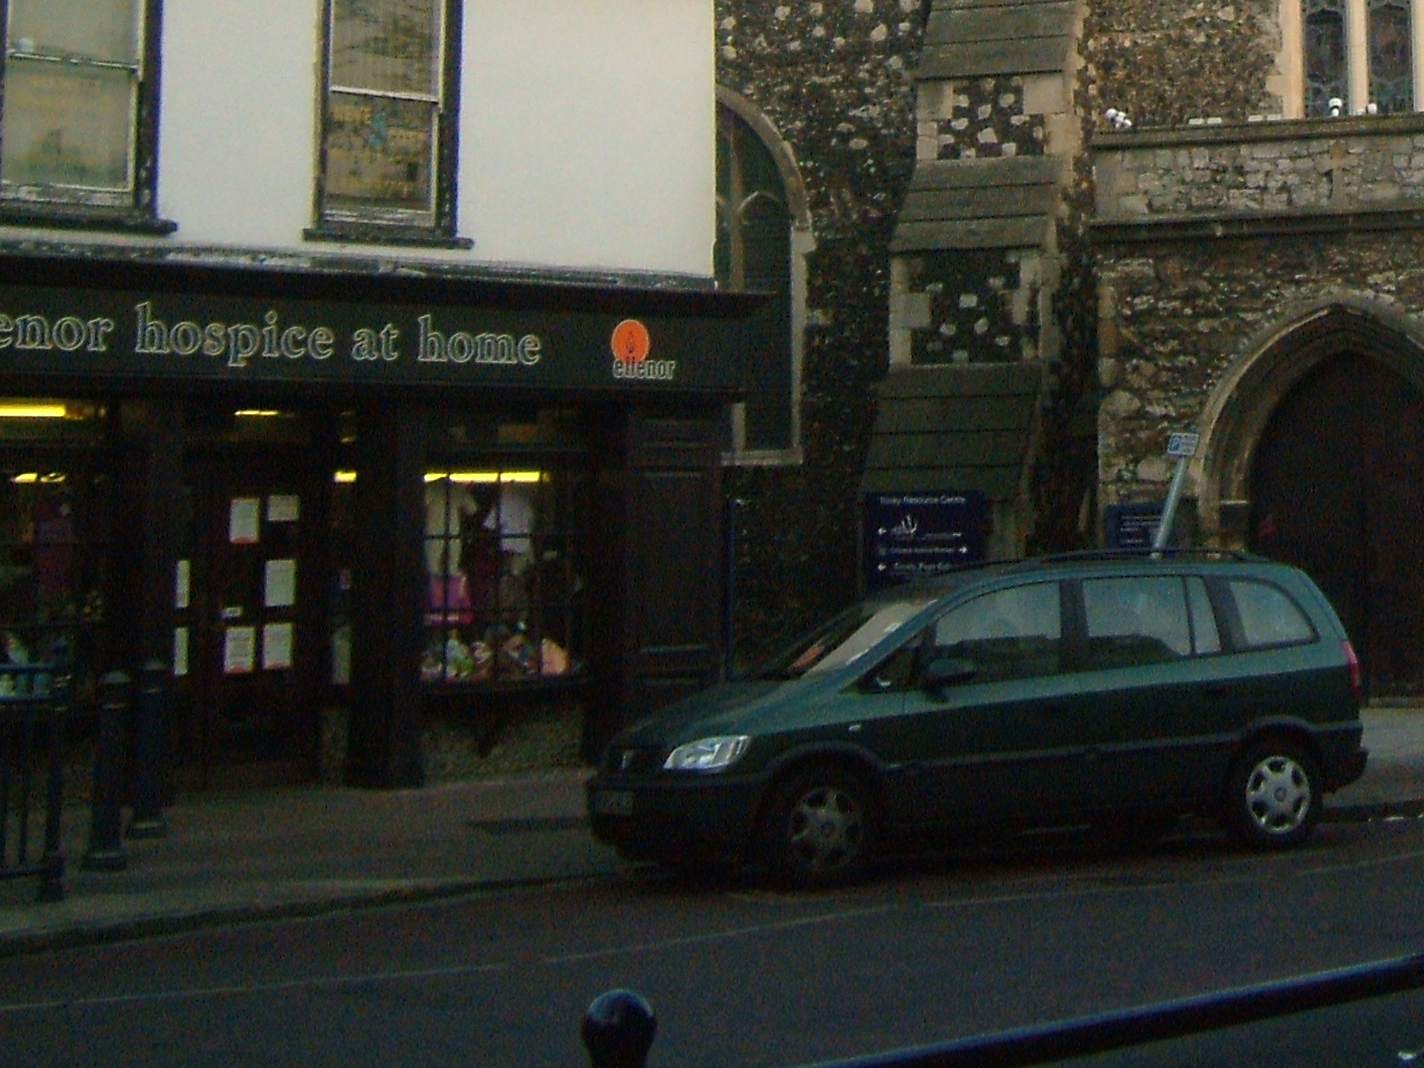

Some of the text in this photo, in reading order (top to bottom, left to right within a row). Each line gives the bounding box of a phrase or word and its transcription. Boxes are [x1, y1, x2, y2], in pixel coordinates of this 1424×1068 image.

[134, 301, 334, 368] hospice
[352, 323, 399, 361] at
[417, 313, 542, 365] home
[612, 354, 677, 380] ellenor
